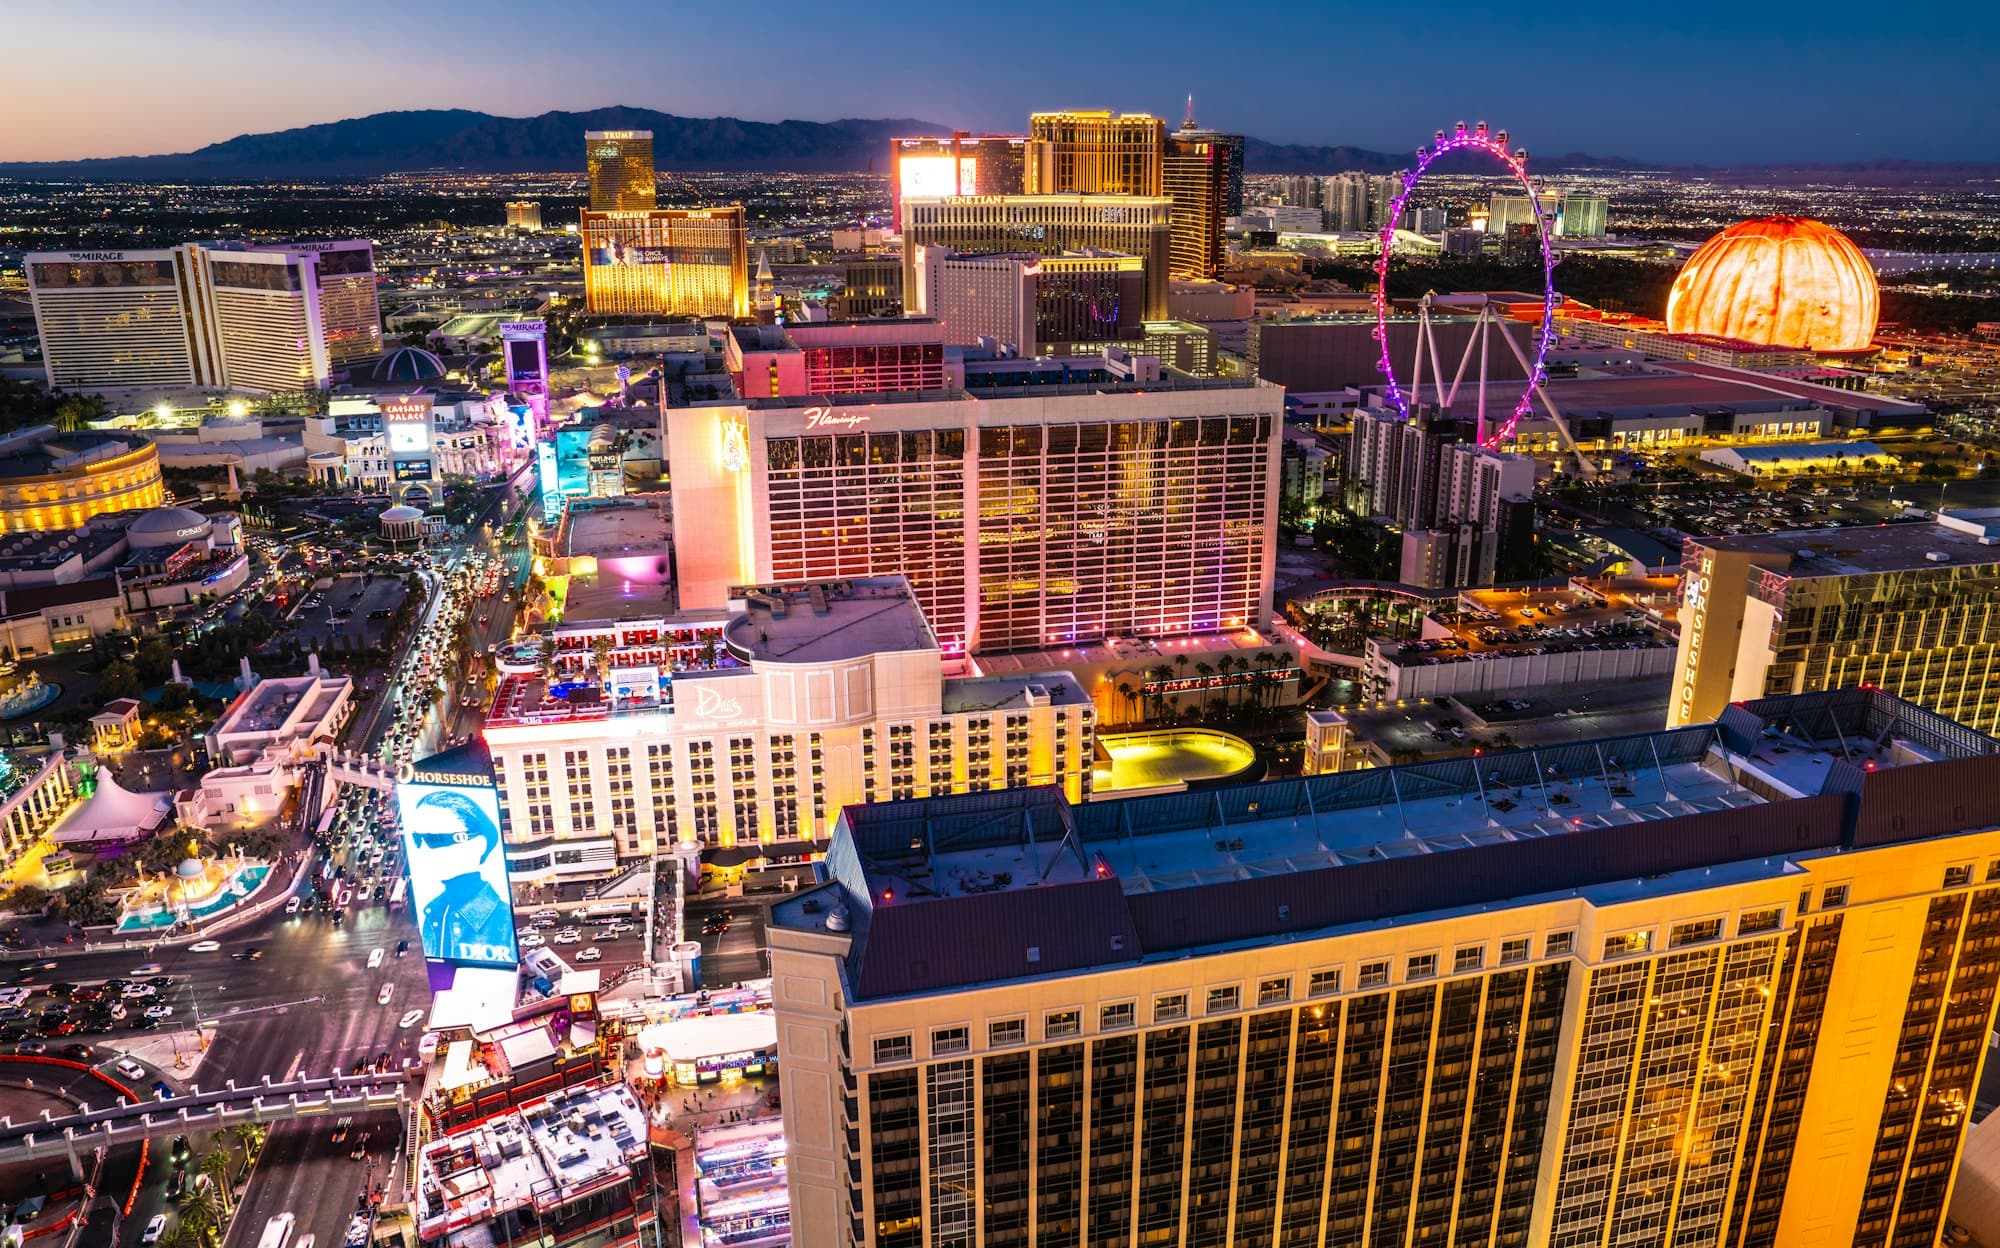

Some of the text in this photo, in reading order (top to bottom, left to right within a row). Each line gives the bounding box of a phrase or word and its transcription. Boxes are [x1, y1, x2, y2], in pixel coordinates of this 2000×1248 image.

[603, 131, 634, 140] TRUMP
[944, 195, 1002, 205] VENETIAN
[606, 211, 712, 219] TREASURE ISLAND
[299, 243, 334, 252] MIRAGE
[80, 252, 124, 261] MIRAGE
[510, 323, 543, 331] MIRAGE
[387, 405, 425, 413] CAESARS
[388, 412, 424, 421] PALACE
[803, 407, 870, 429] Flamingo
[1680, 558, 1712, 720] HORSESHOE
[414, 771, 492, 786] HORSESHOE
[459, 942, 513, 962] DIOR
[751, 1056, 766, 1065] YOU
